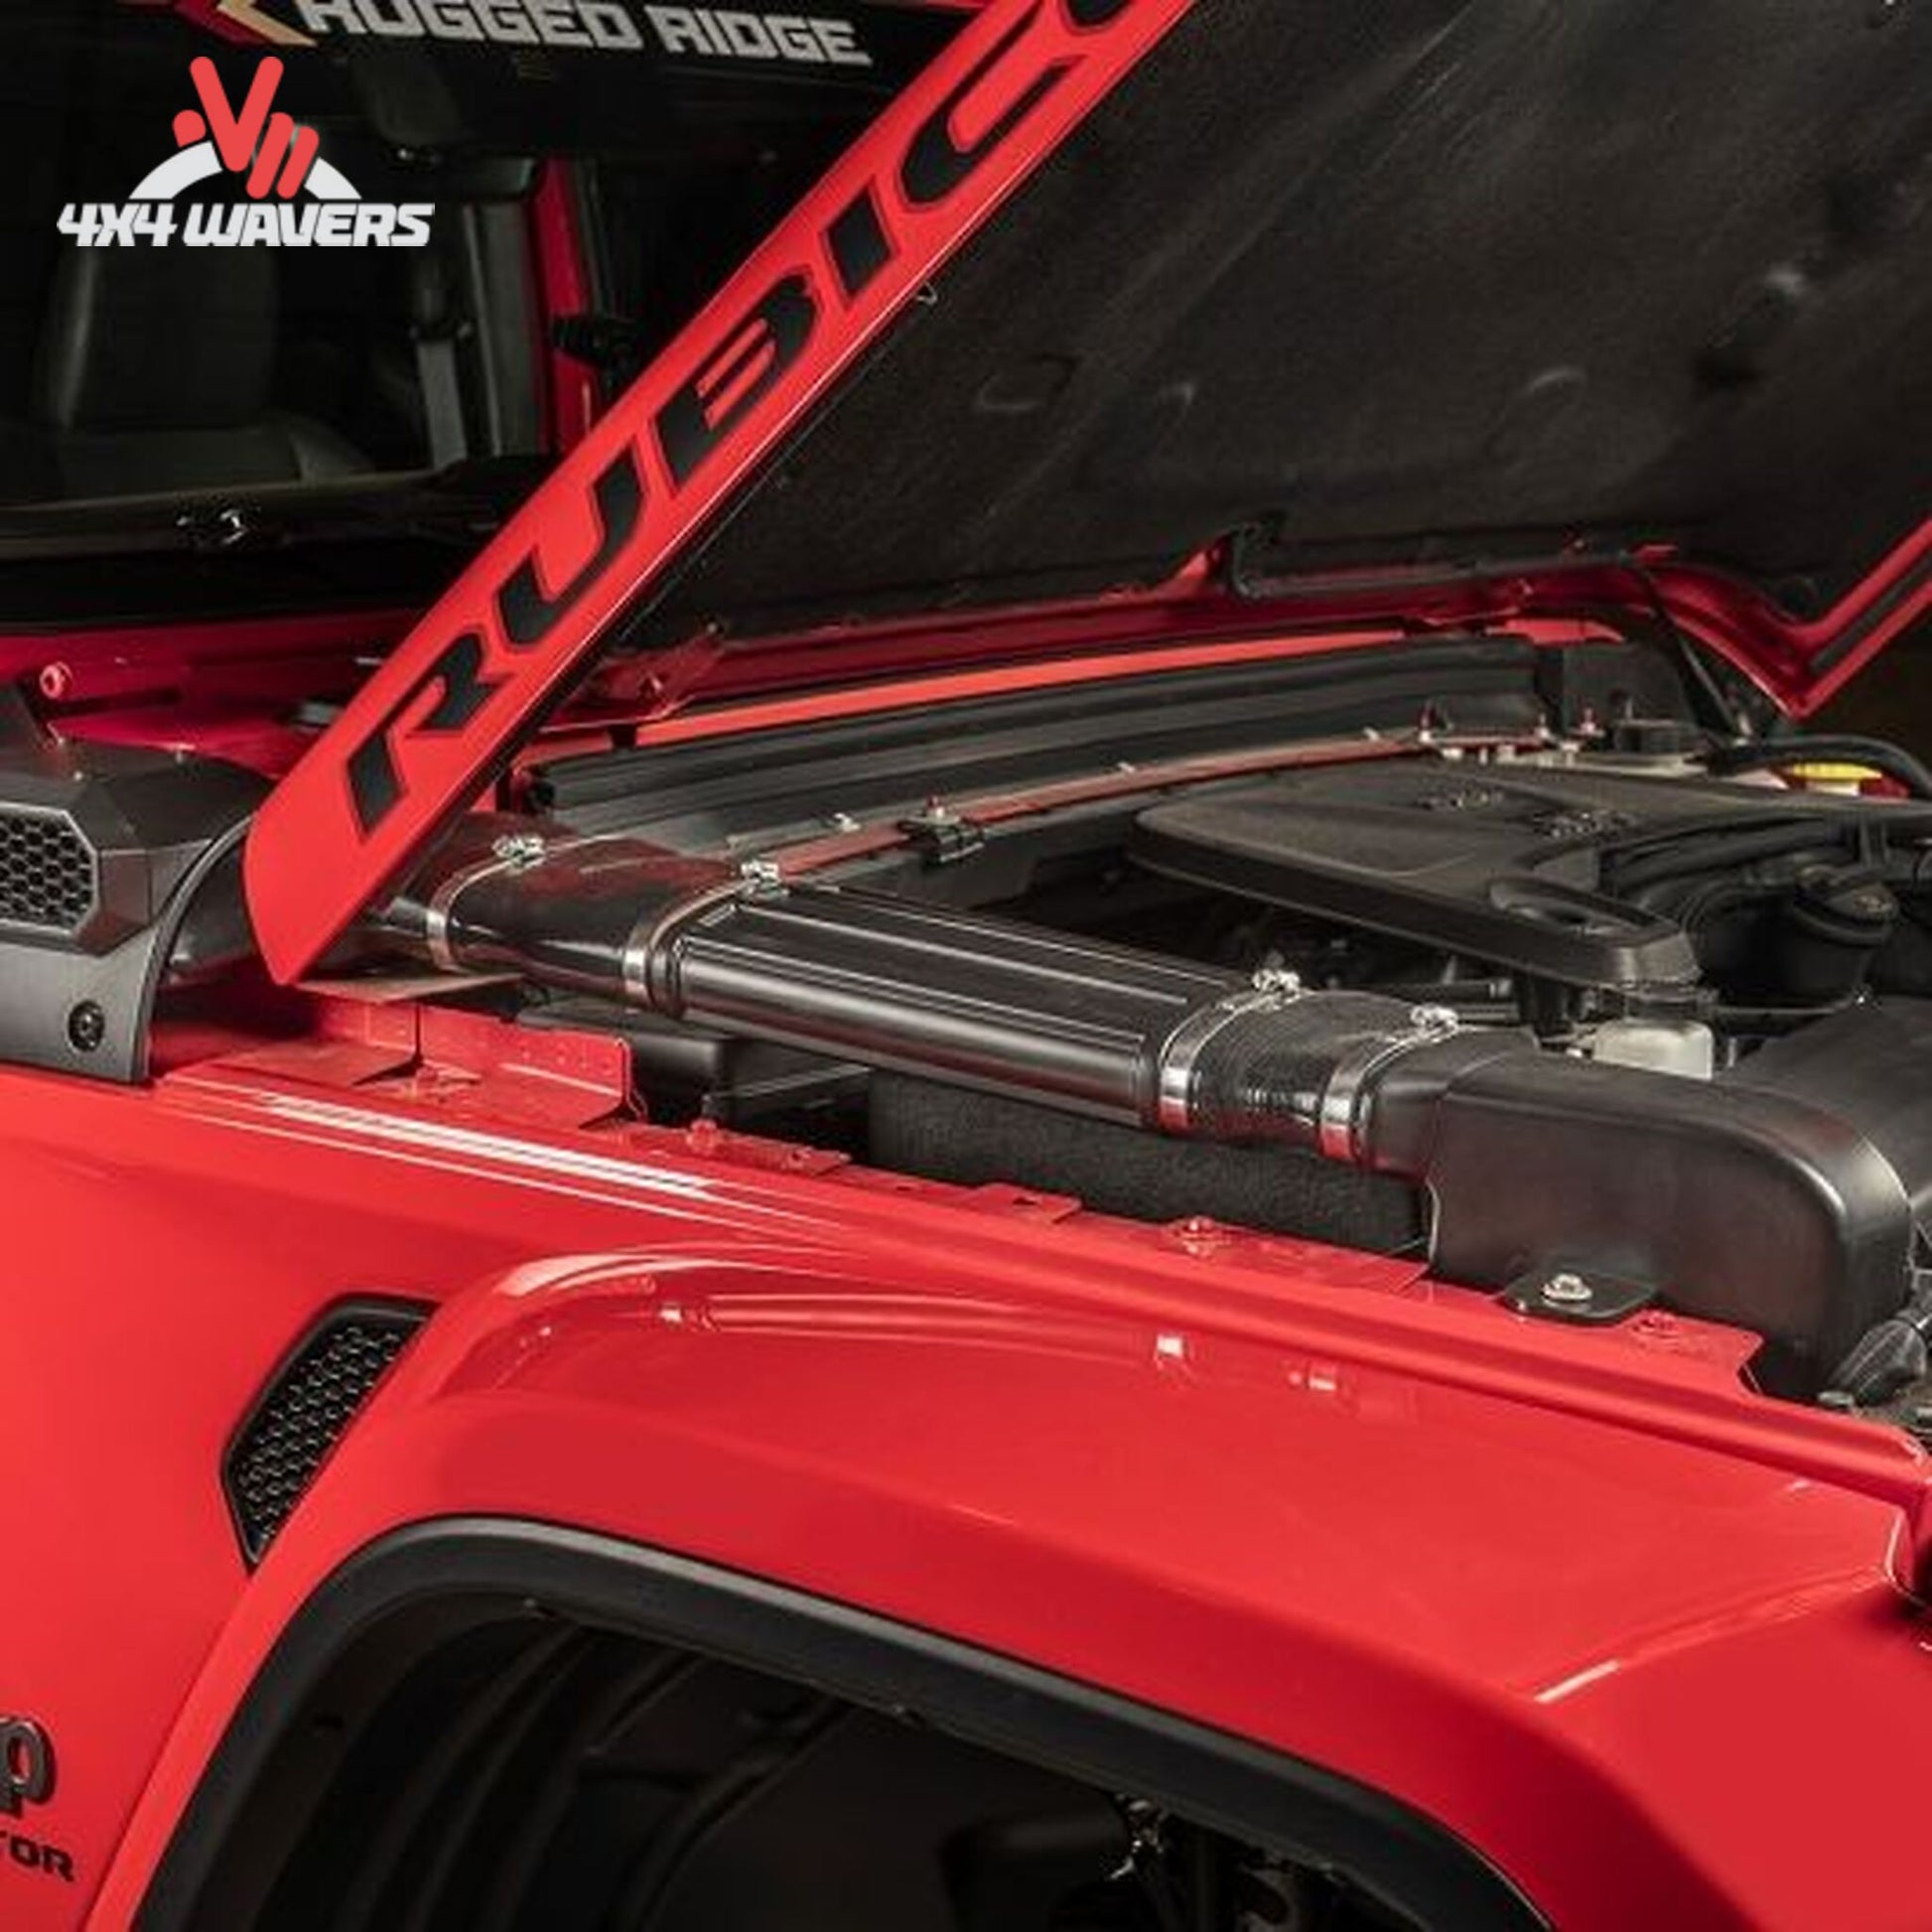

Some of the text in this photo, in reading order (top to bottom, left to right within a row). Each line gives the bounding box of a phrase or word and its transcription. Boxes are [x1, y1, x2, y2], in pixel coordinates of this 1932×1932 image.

[299, 0, 873, 67] RUGGED RIDGE
[345, 0, 1136, 840] RUBIC
[0, 1831, 74, 1882] OR
